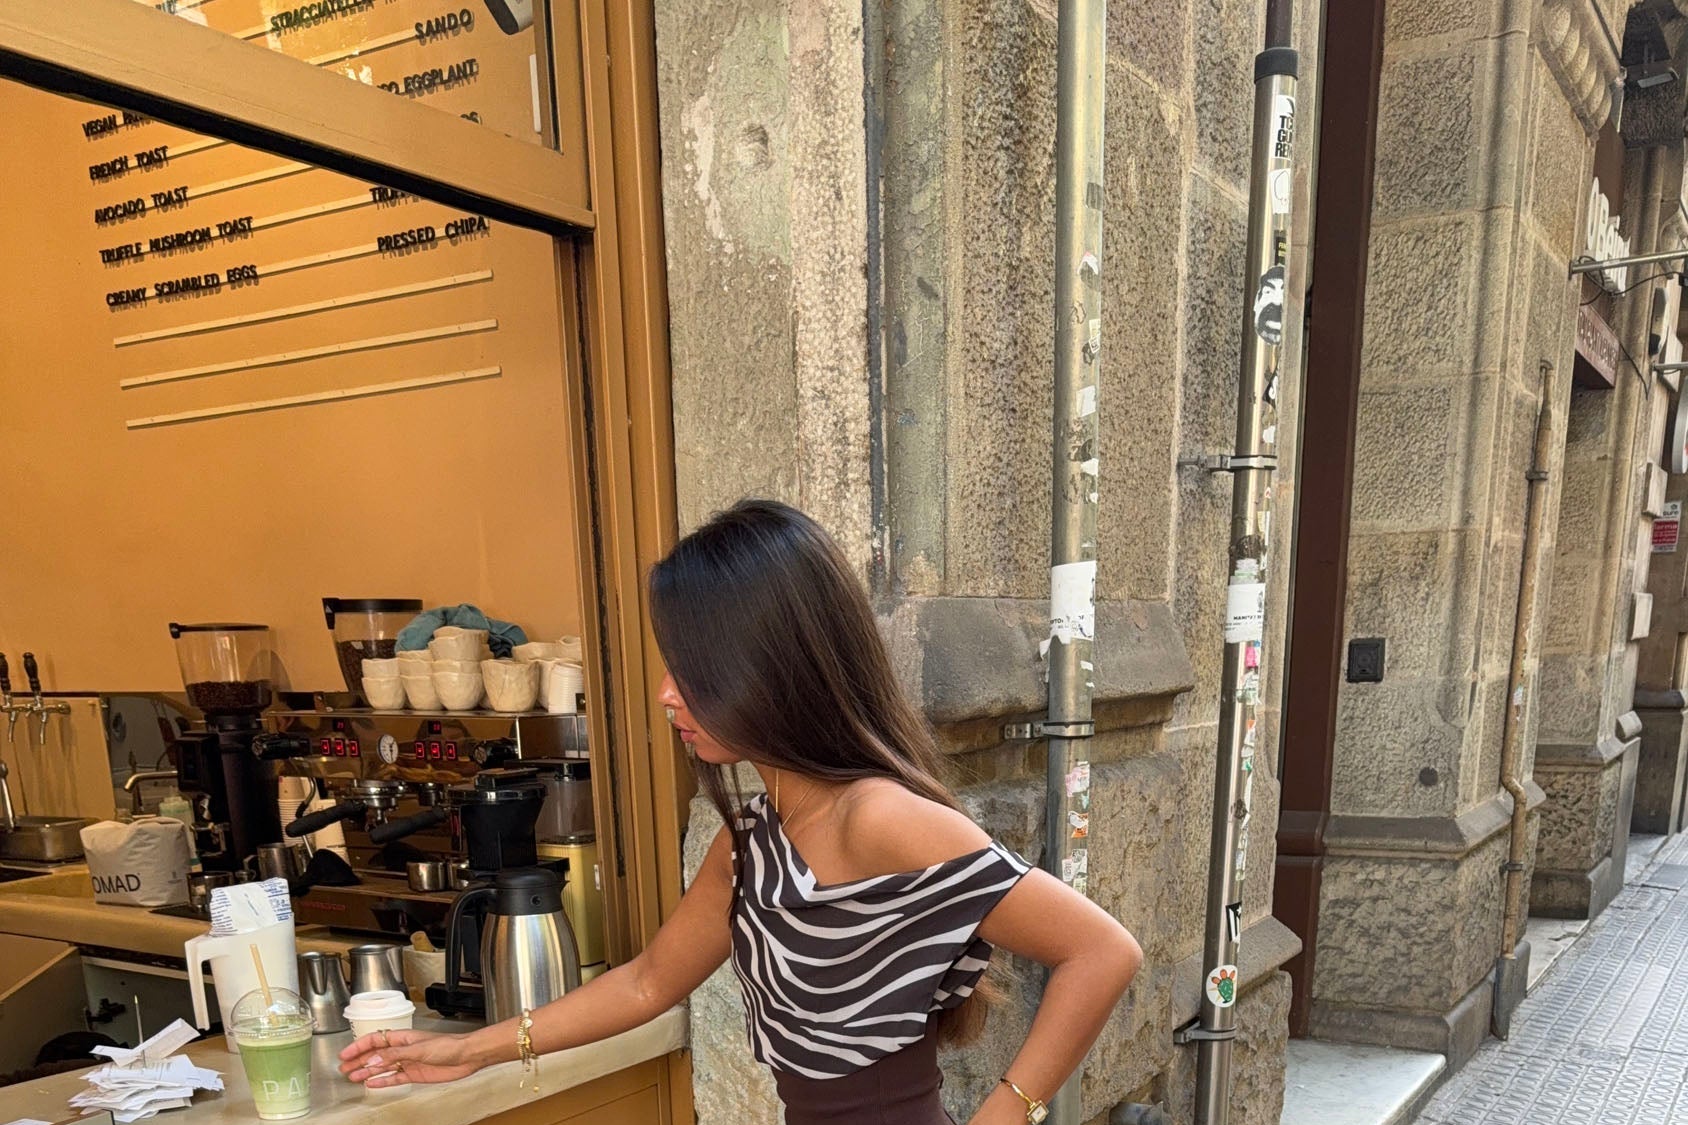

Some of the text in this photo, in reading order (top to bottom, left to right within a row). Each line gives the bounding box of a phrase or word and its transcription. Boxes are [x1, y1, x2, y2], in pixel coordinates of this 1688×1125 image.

[415, 9, 473, 39] SANDO
[403, 58, 477, 93] EGGPLANT
[82, 114, 117, 137] VEGAN
[89, 145, 168, 180] FRENCH TOAST
[94, 186, 188, 224] AVOCADO TOAST
[99, 216, 253, 264] TRUFFLE MUSHROOM TOAST
[377, 215, 488, 251] PRESSED CHIPA
[106, 264, 259, 307] CREAMY SCRAMBLED EGGS
